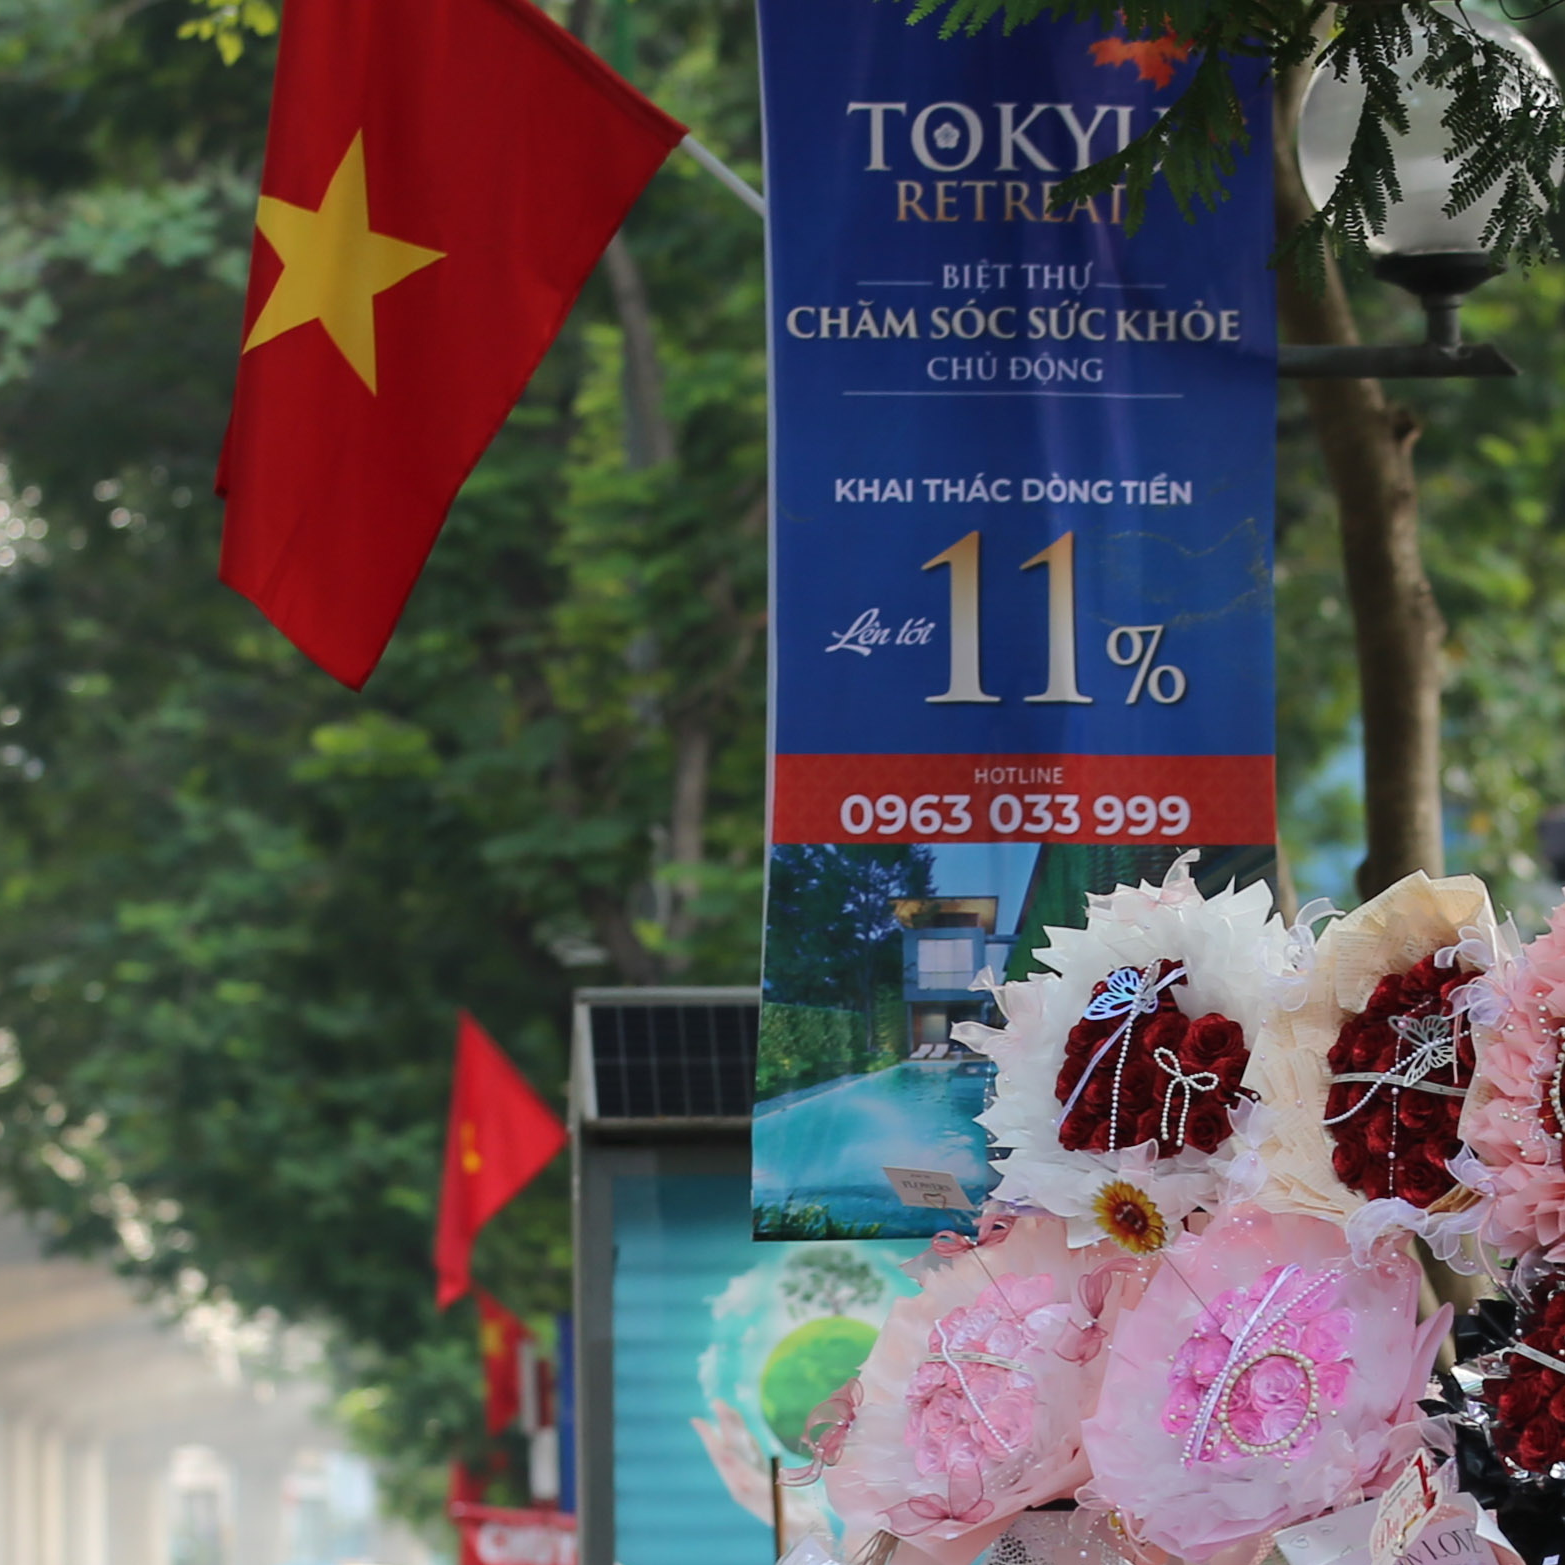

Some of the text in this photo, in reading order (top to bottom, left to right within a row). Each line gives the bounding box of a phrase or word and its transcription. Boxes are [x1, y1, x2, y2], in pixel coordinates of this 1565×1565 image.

[941, 258, 1094, 296] BIỆT THỰ
[787, 298, 1242, 345] CHĂM SÓC SỨC KHỎE
[926, 350, 1104, 386] CHỦ ĐỘNG
[835, 478, 913, 503] KHAI
[923, 472, 1012, 504] THÁC
[1021, 477, 1114, 505] DÒNG
[824, 607, 891, 657] Lên
[895, 616, 936, 646] tới
[974, 766, 1064, 785] HOTLINE
[840, 795, 1192, 837] 0963 033 999
